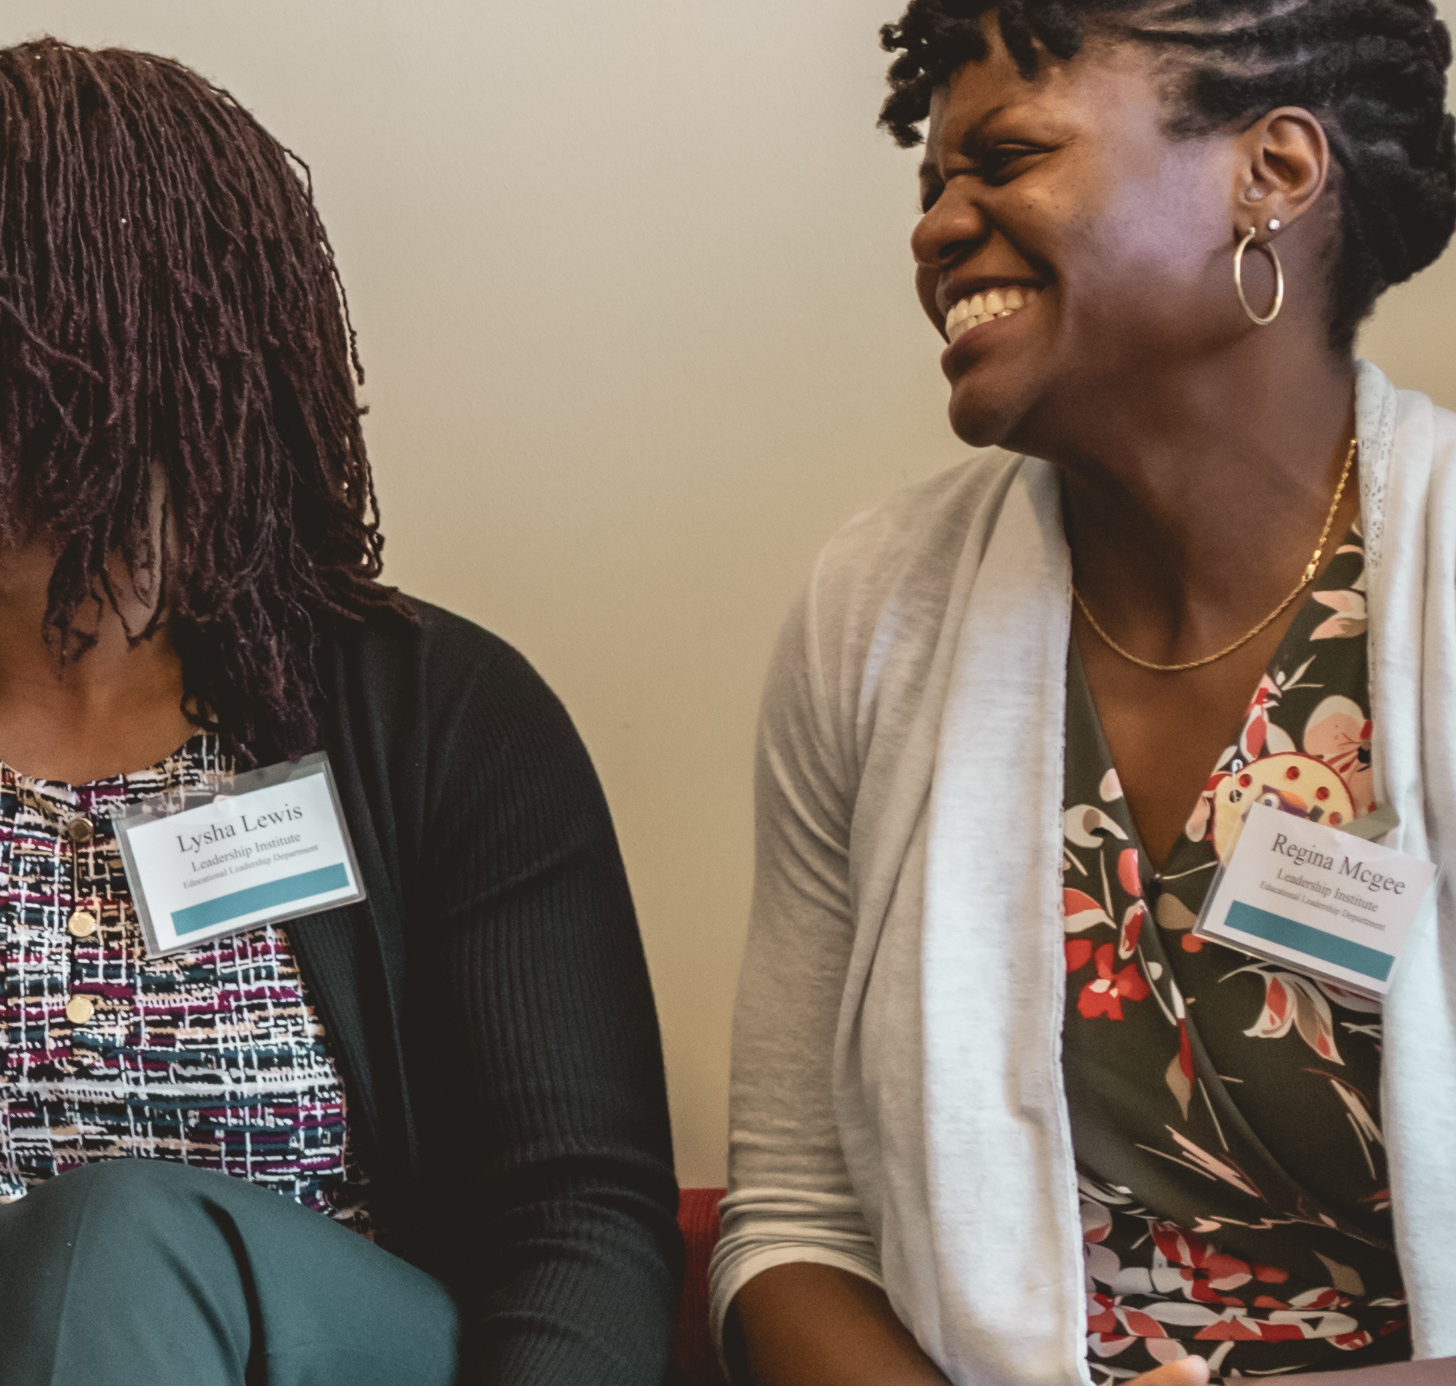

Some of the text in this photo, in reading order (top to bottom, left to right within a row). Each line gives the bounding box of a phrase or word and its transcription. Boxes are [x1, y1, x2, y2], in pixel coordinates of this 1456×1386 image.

[176, 803, 303, 853] Lysha Lewis
[182, 844, 319, 889] Educational Leadership Department
[191, 833, 301, 872] Leadership Institute
[1271, 832, 1406, 895] Regina Mcgee
[1277, 868, 1379, 913] Leadership Institute
